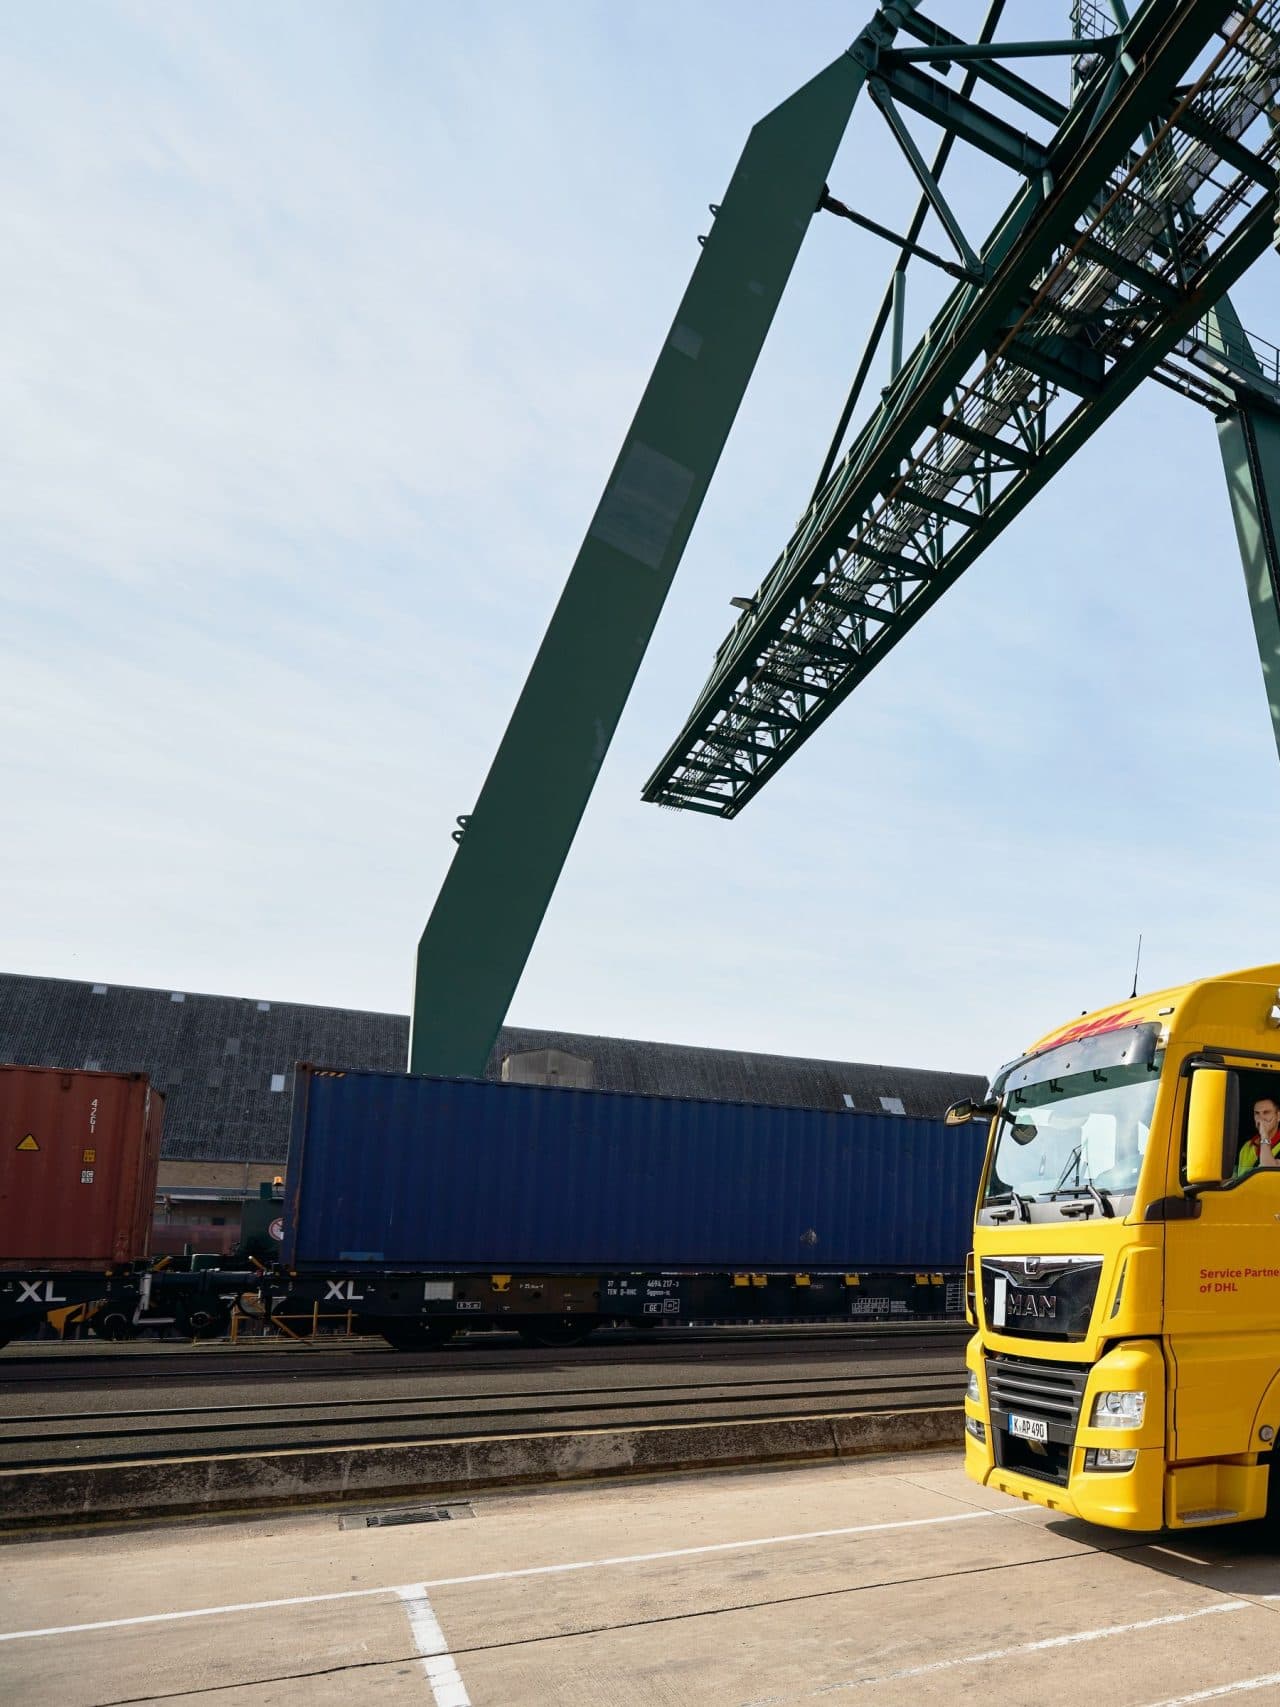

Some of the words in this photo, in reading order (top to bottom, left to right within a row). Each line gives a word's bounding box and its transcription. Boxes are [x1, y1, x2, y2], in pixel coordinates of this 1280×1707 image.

[1200, 1268, 1242, 1279] Service
[15, 1280, 67, 1302] XL
[323, 1280, 364, 1300] XL
[1200, 1283, 1212, 1293] of
[1214, 1282, 1239, 1292] DHL
[1008, 1294, 1056, 1317] MAN
